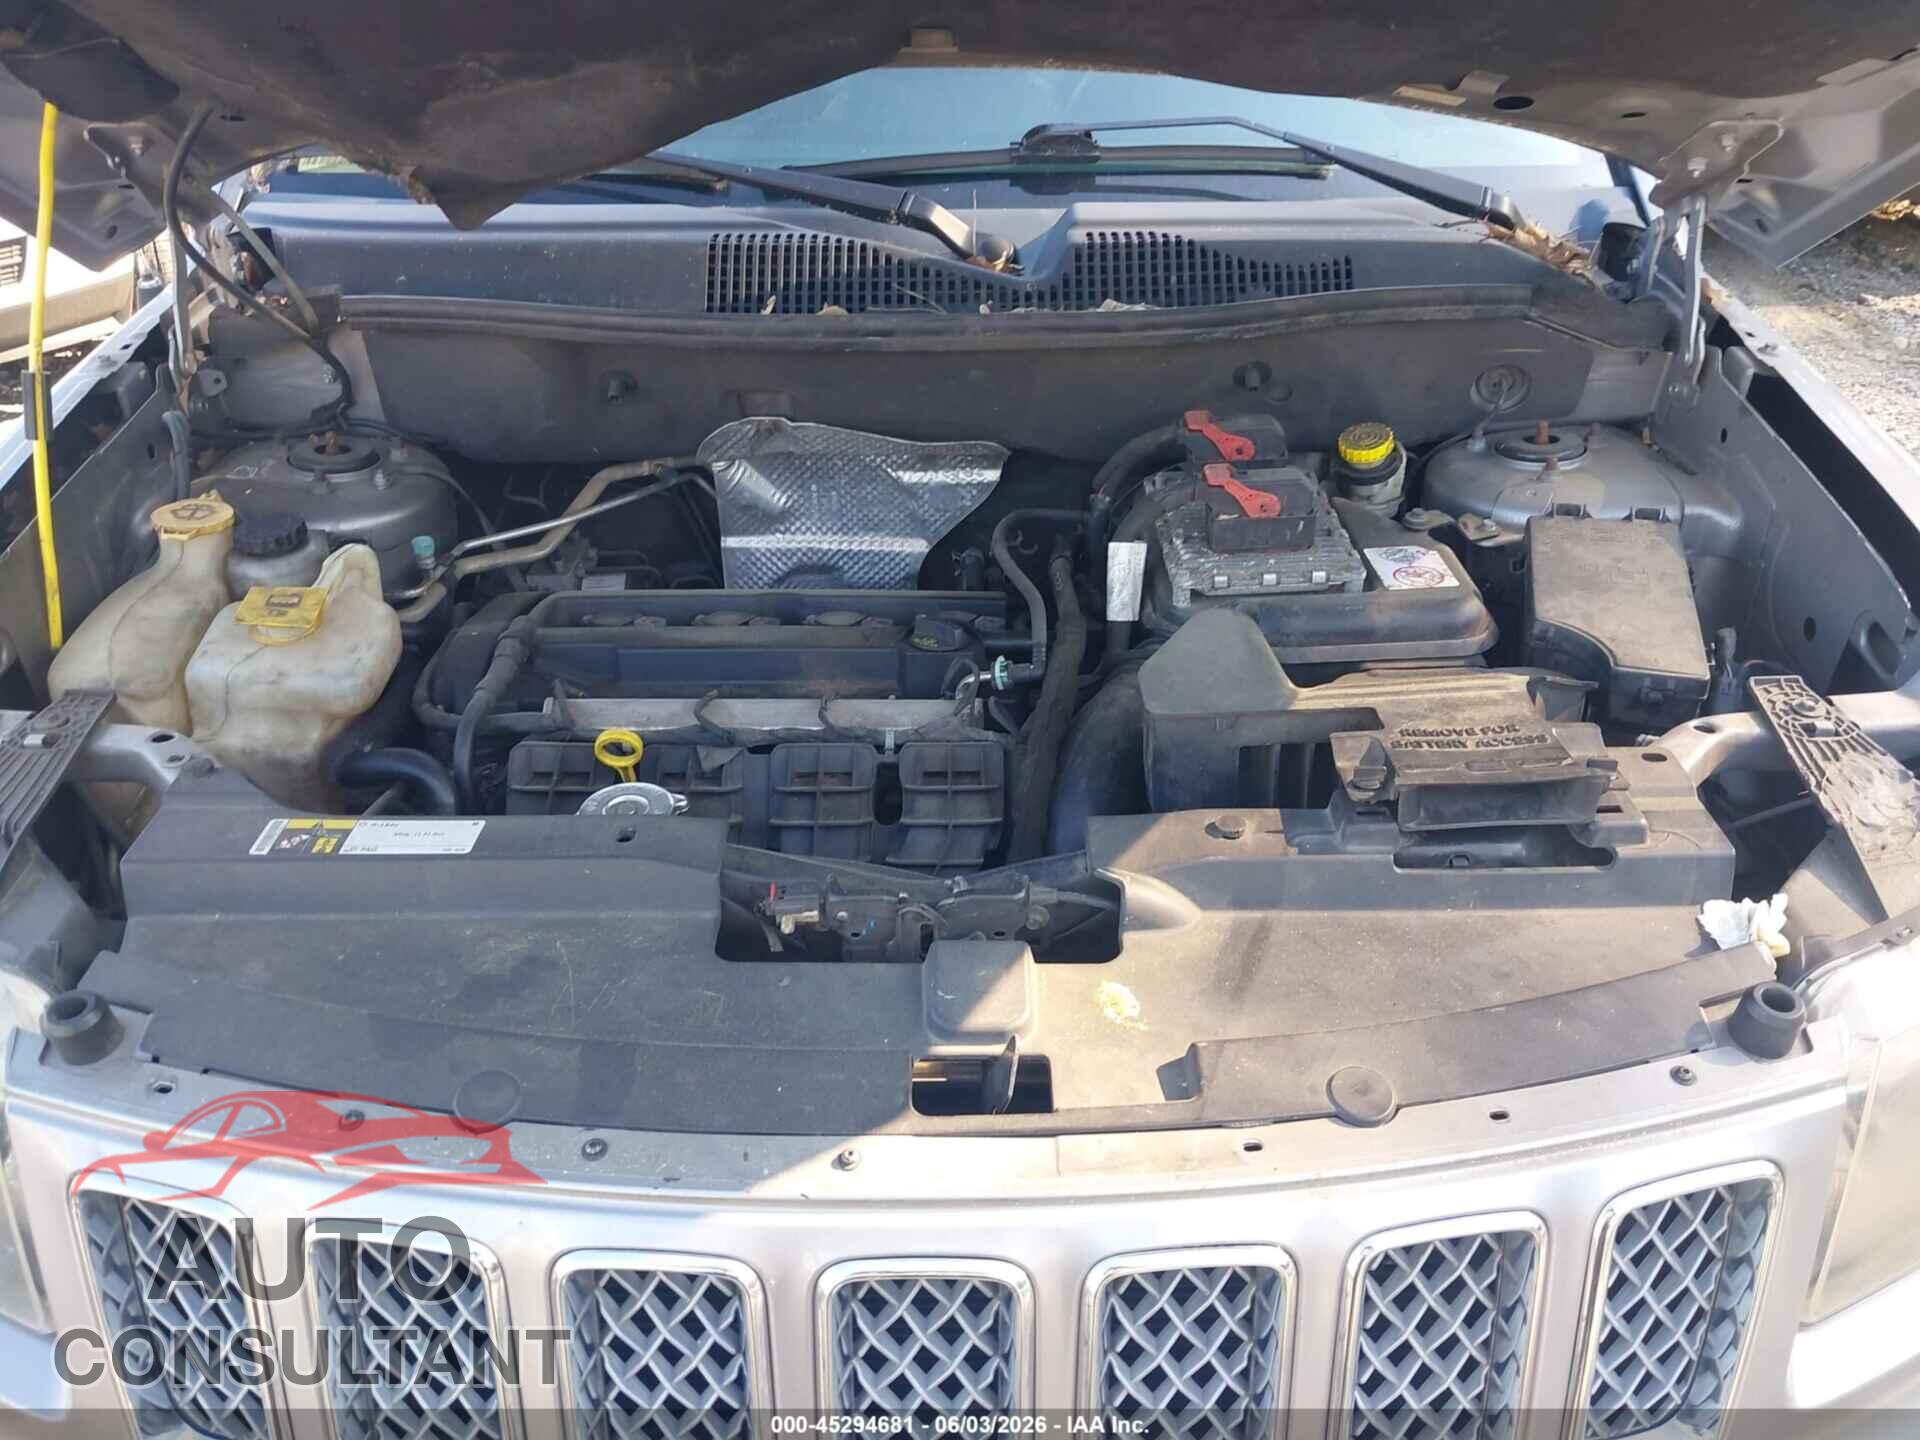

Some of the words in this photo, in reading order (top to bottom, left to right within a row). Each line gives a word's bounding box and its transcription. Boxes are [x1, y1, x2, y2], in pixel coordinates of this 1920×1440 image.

[1399, 727, 1478, 738] REMOVE
[1479, 724, 1520, 736] FOR
[1391, 739, 1469, 749] BATTERY
[1475, 734, 1549, 748] ACCESS
